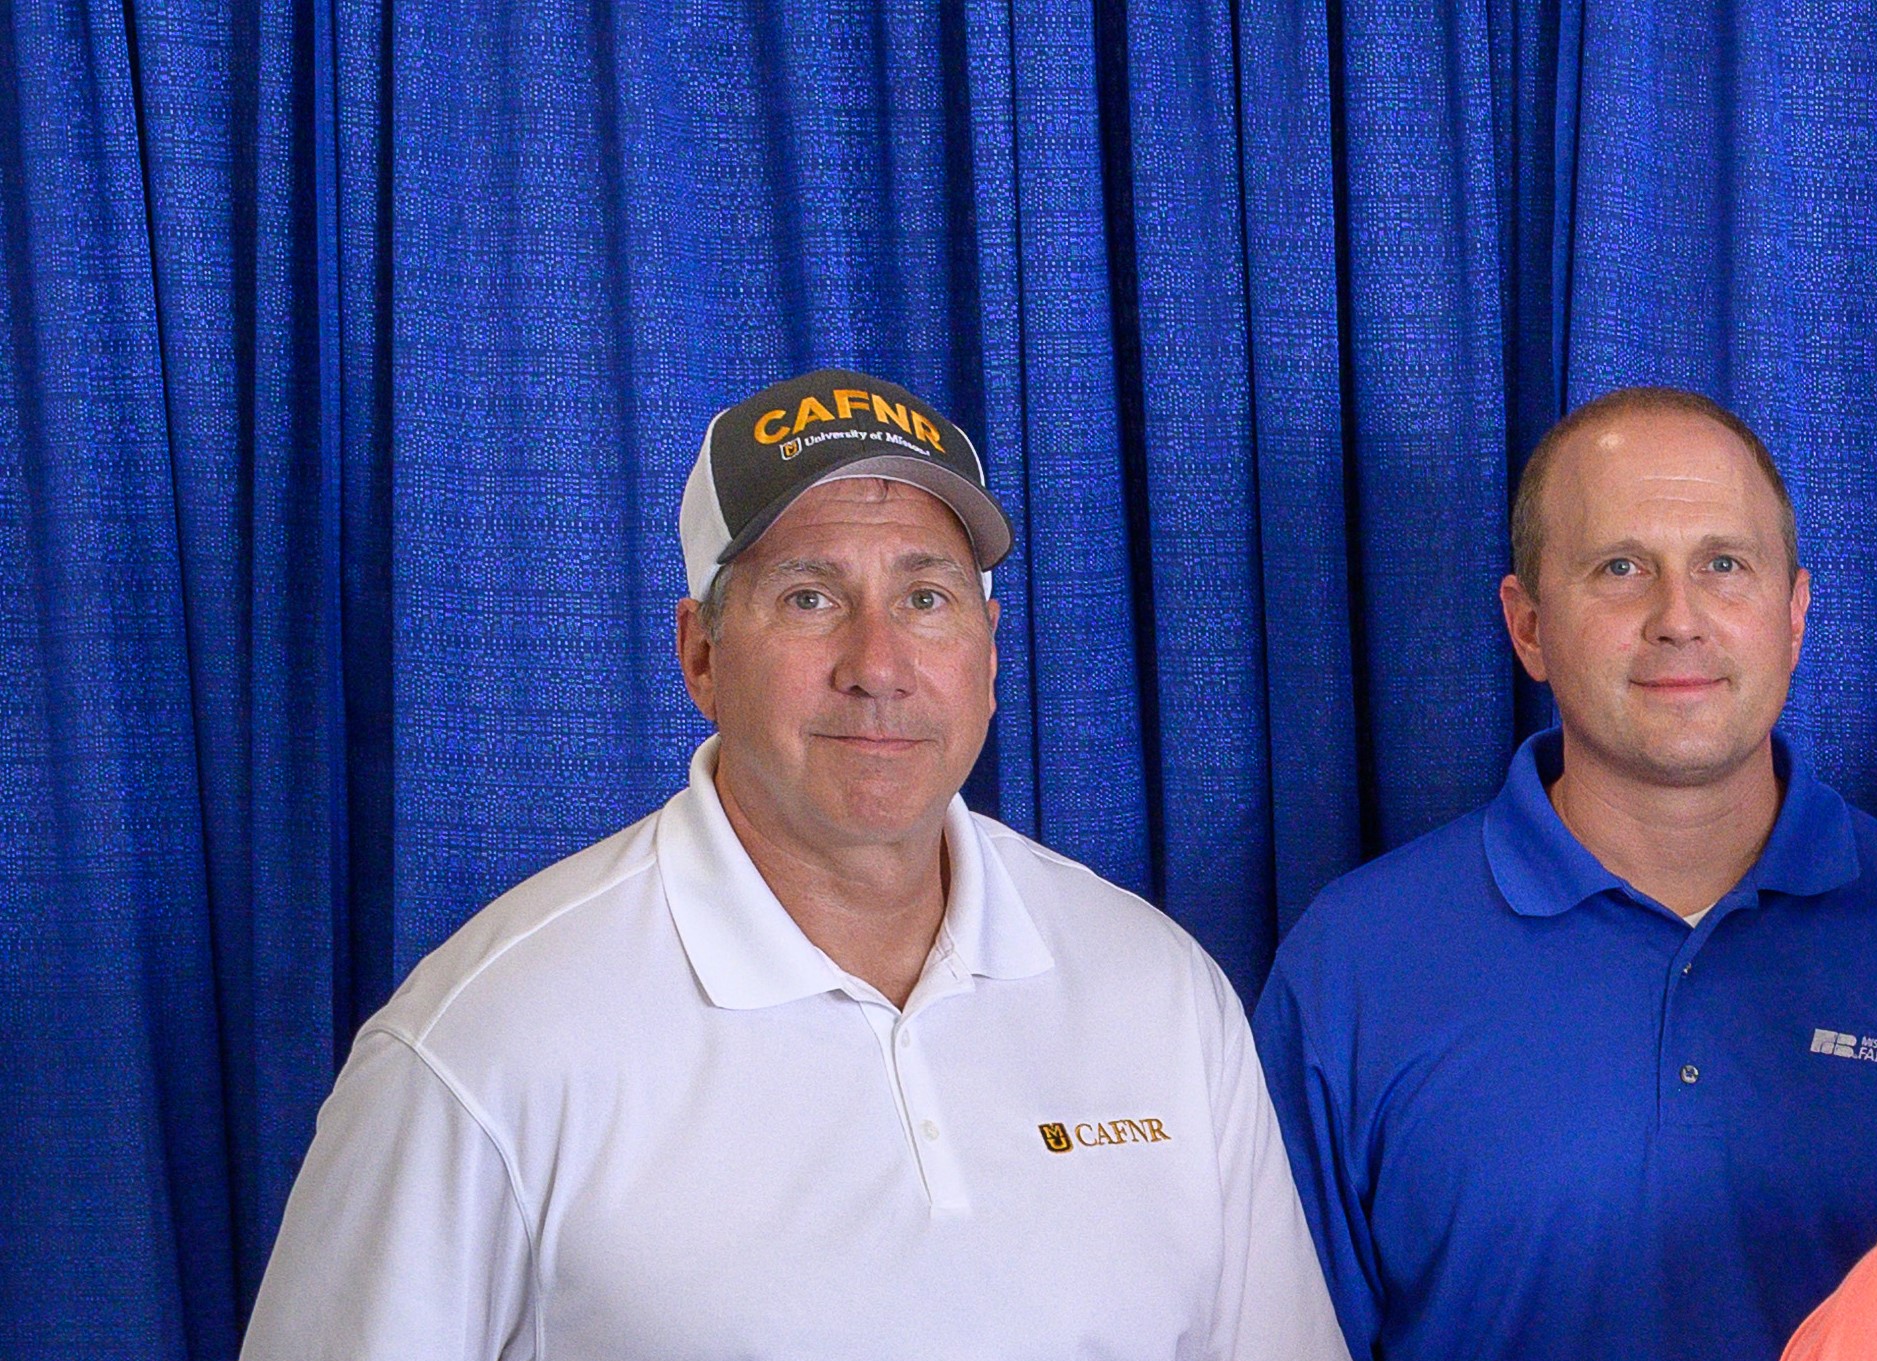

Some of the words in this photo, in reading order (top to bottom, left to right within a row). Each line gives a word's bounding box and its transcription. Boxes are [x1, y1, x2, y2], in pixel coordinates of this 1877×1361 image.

[754, 389, 945, 453] CAFNR
[804, 429, 867, 447] University
[869, 431, 883, 441] of
[1074, 1118, 1172, 1147] CAFNR
